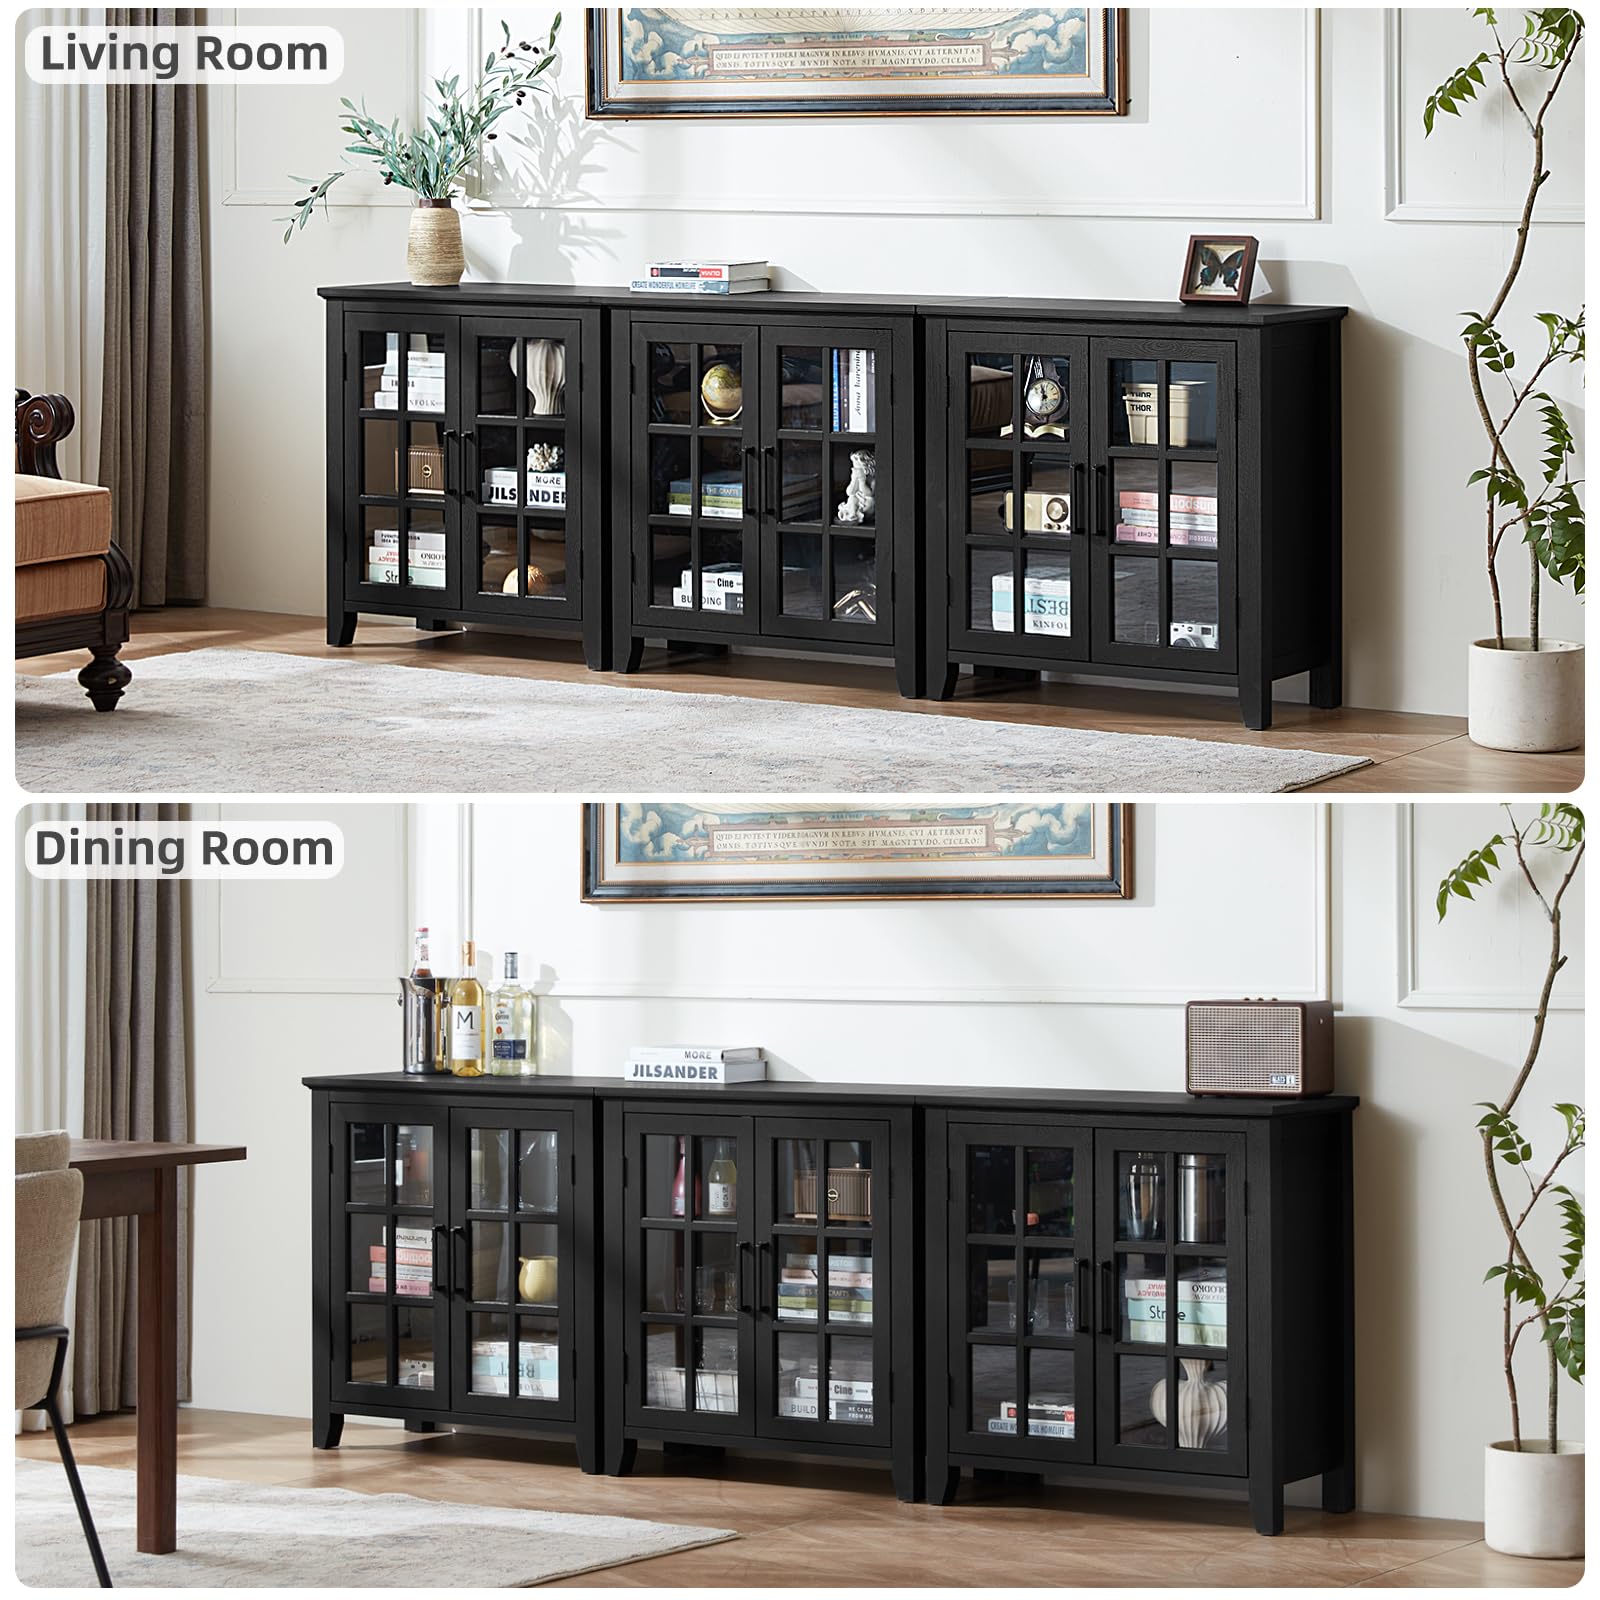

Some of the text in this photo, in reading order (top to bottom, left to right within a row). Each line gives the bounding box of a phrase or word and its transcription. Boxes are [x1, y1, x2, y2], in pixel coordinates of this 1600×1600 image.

[1130, 404, 1152, 412] THOR
[535, 475, 561, 485] MORE
[717, 577, 734, 589] Cine
[1027, 598, 1069, 617] BEST
[456, 1010, 475, 1030] M
[684, 1050, 712, 1060] MORE
[632, 1063, 719, 1080] JILSANDER
[834, 1384, 853, 1396] Cine
